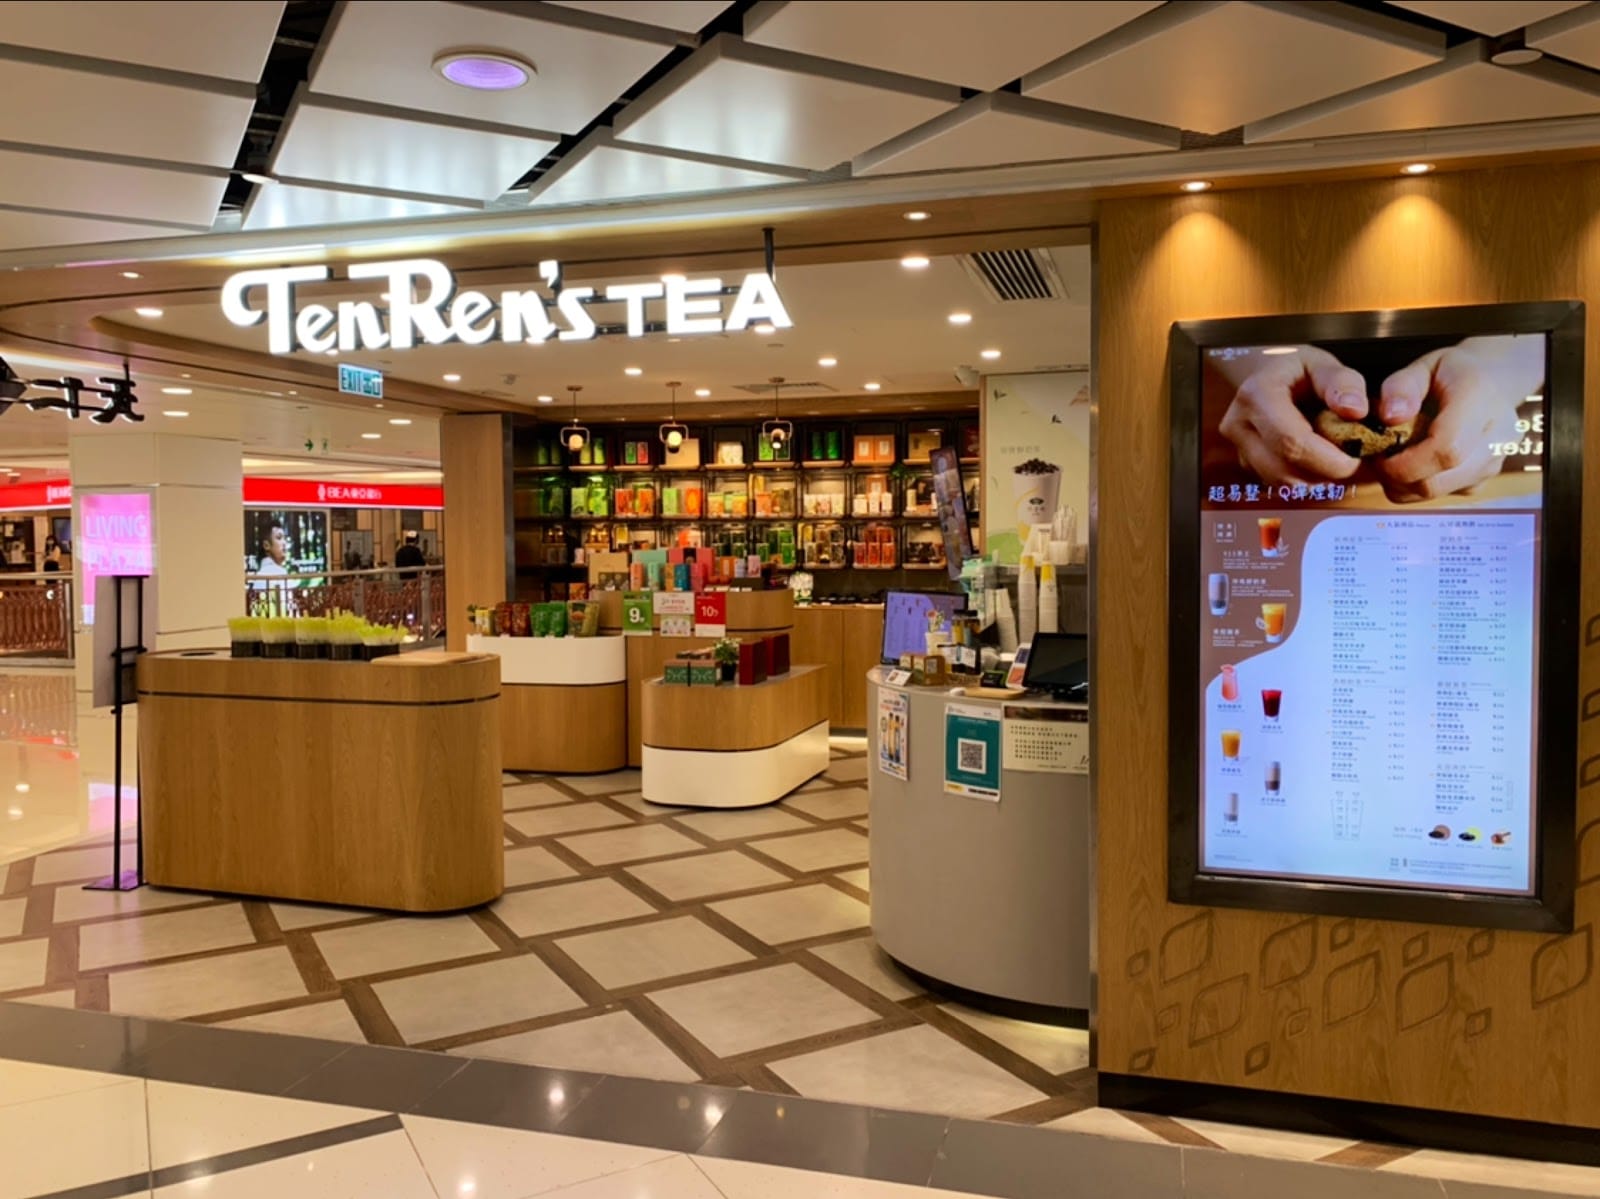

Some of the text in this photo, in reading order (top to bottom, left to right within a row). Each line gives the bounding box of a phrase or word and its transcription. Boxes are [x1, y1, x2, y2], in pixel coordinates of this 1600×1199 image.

[606, 272, 794, 336] TEA
[341, 366, 362, 393] EXIT
[327, 486, 350, 499] BEA
[85, 513, 148, 538] LIVING
[86, 545, 148, 572] PLAZA
